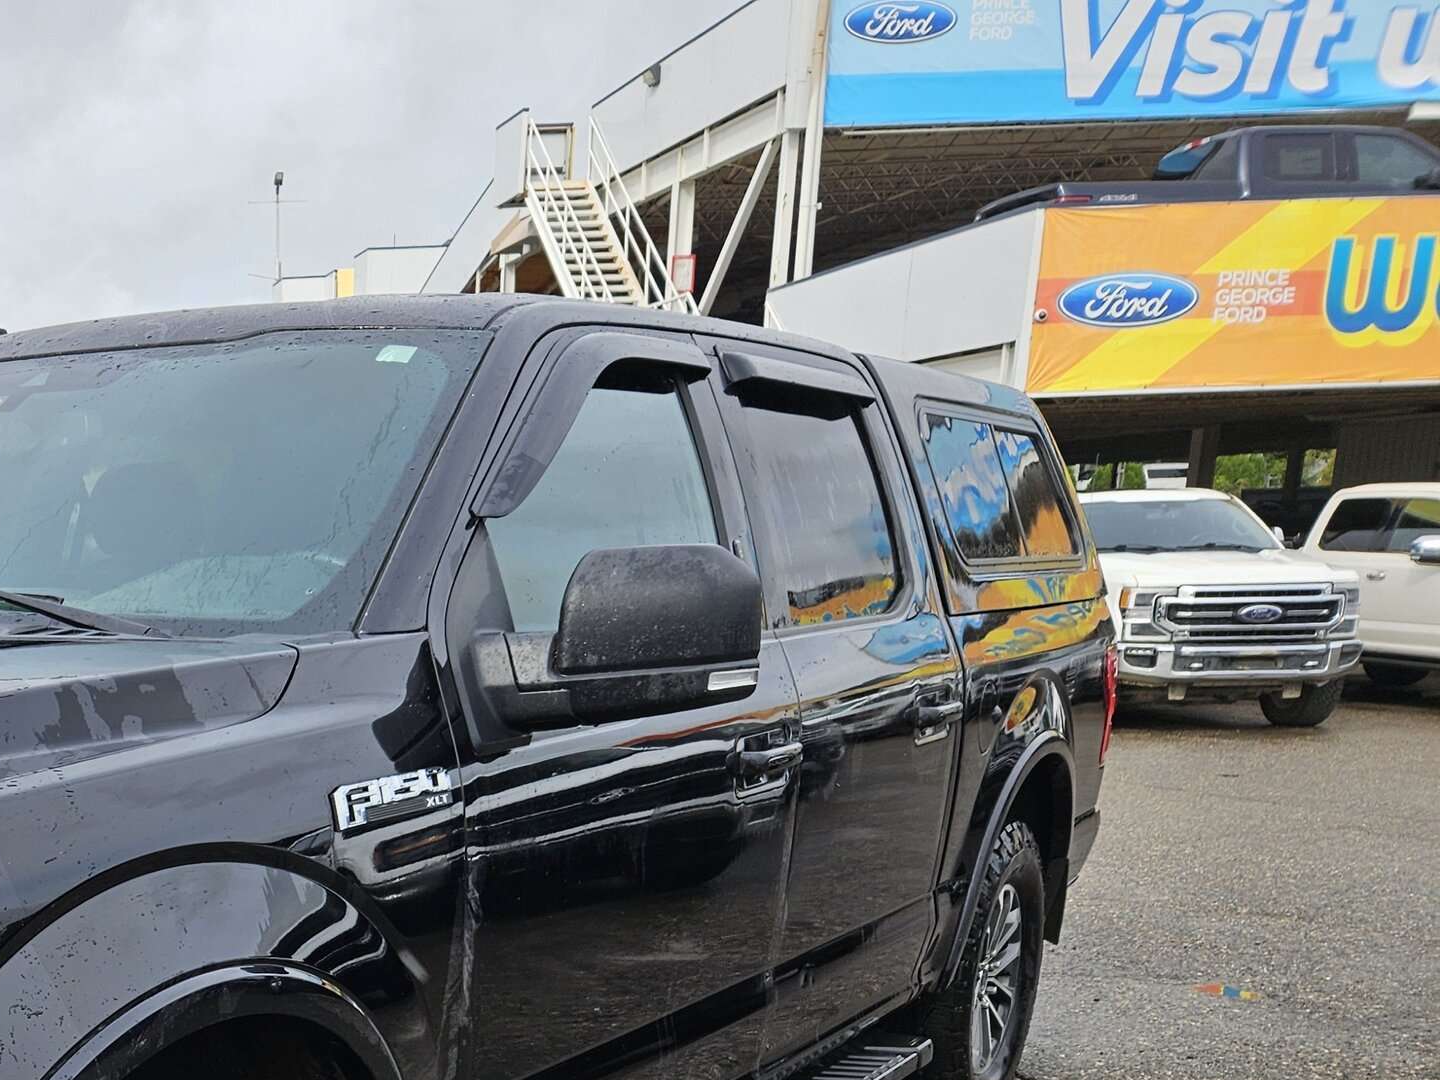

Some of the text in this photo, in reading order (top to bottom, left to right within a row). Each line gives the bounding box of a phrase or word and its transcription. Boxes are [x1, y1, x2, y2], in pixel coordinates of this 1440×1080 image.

[864, 4, 936, 37] Ford
[969, 9, 1036, 26] GEORGE
[968, 25, 1014, 41] FORD
[1060, 0, 1347, 99] Visit
[1217, 268, 1292, 288] PRINCE
[1084, 280, 1173, 319] Ford
[1215, 286, 1297, 307] GEORGE
[1212, 305, 1267, 325] FORD
[425, 793, 450, 809] XLT
